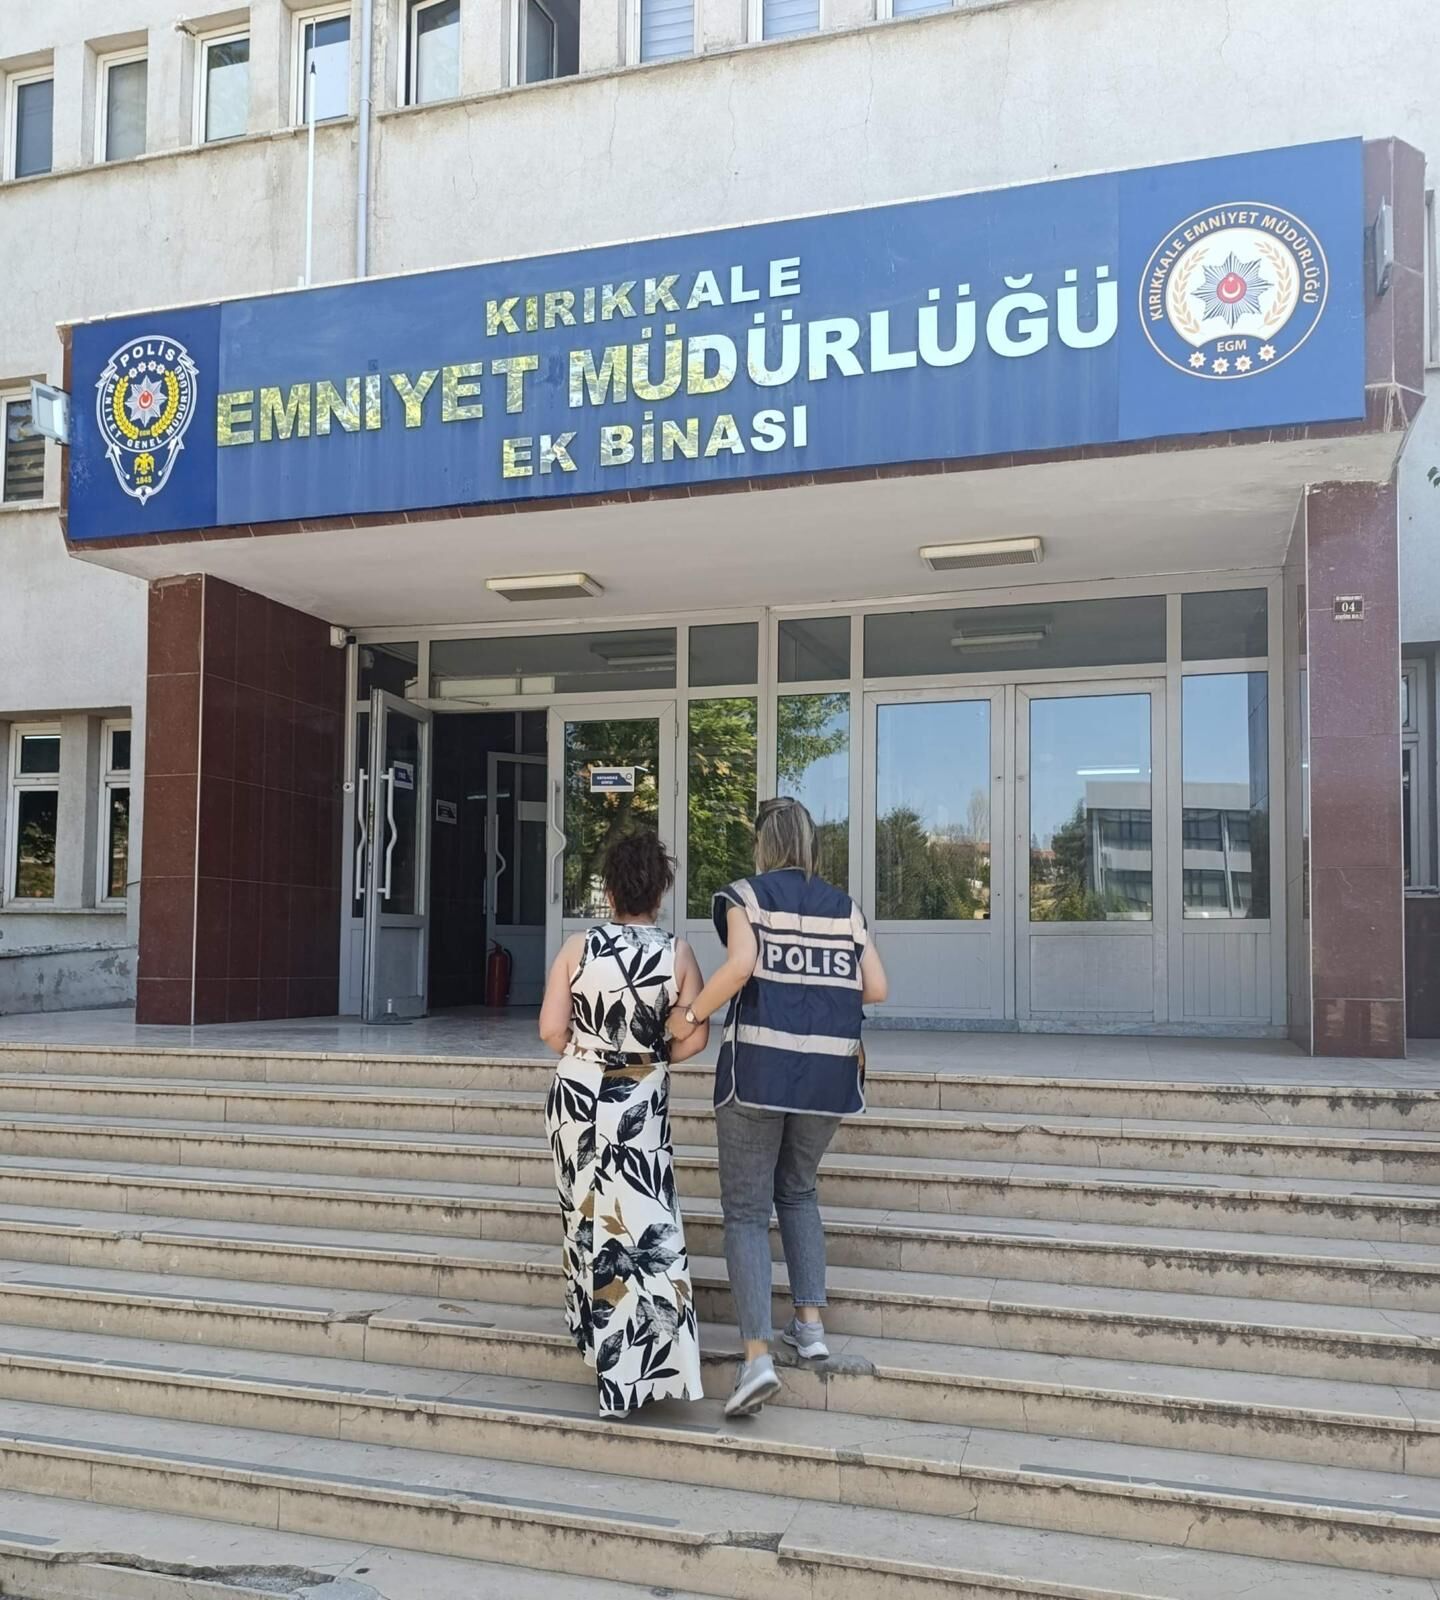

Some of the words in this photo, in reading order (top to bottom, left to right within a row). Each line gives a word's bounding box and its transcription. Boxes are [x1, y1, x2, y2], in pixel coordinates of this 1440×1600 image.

[1149, 238, 1185, 321] KIRIKKALE
[1183, 211, 1260, 242] EMNİYET
[1260, 214, 1321, 304] MÜDÜRLÜĞÜ
[486, 256, 801, 337] KIRIKKALE
[568, 264, 1119, 409] MÜDÜRLÜĞÜ
[1216, 339, 1248, 353] EGM
[119, 341, 176, 368] POLİS
[126, 437, 163, 449] GENEL
[502, 431, 578, 479] EK
[599, 404, 808, 467] BİNASI
[1341, 601, 1356, 613] 04
[766, 942, 852, 977] POLİS
